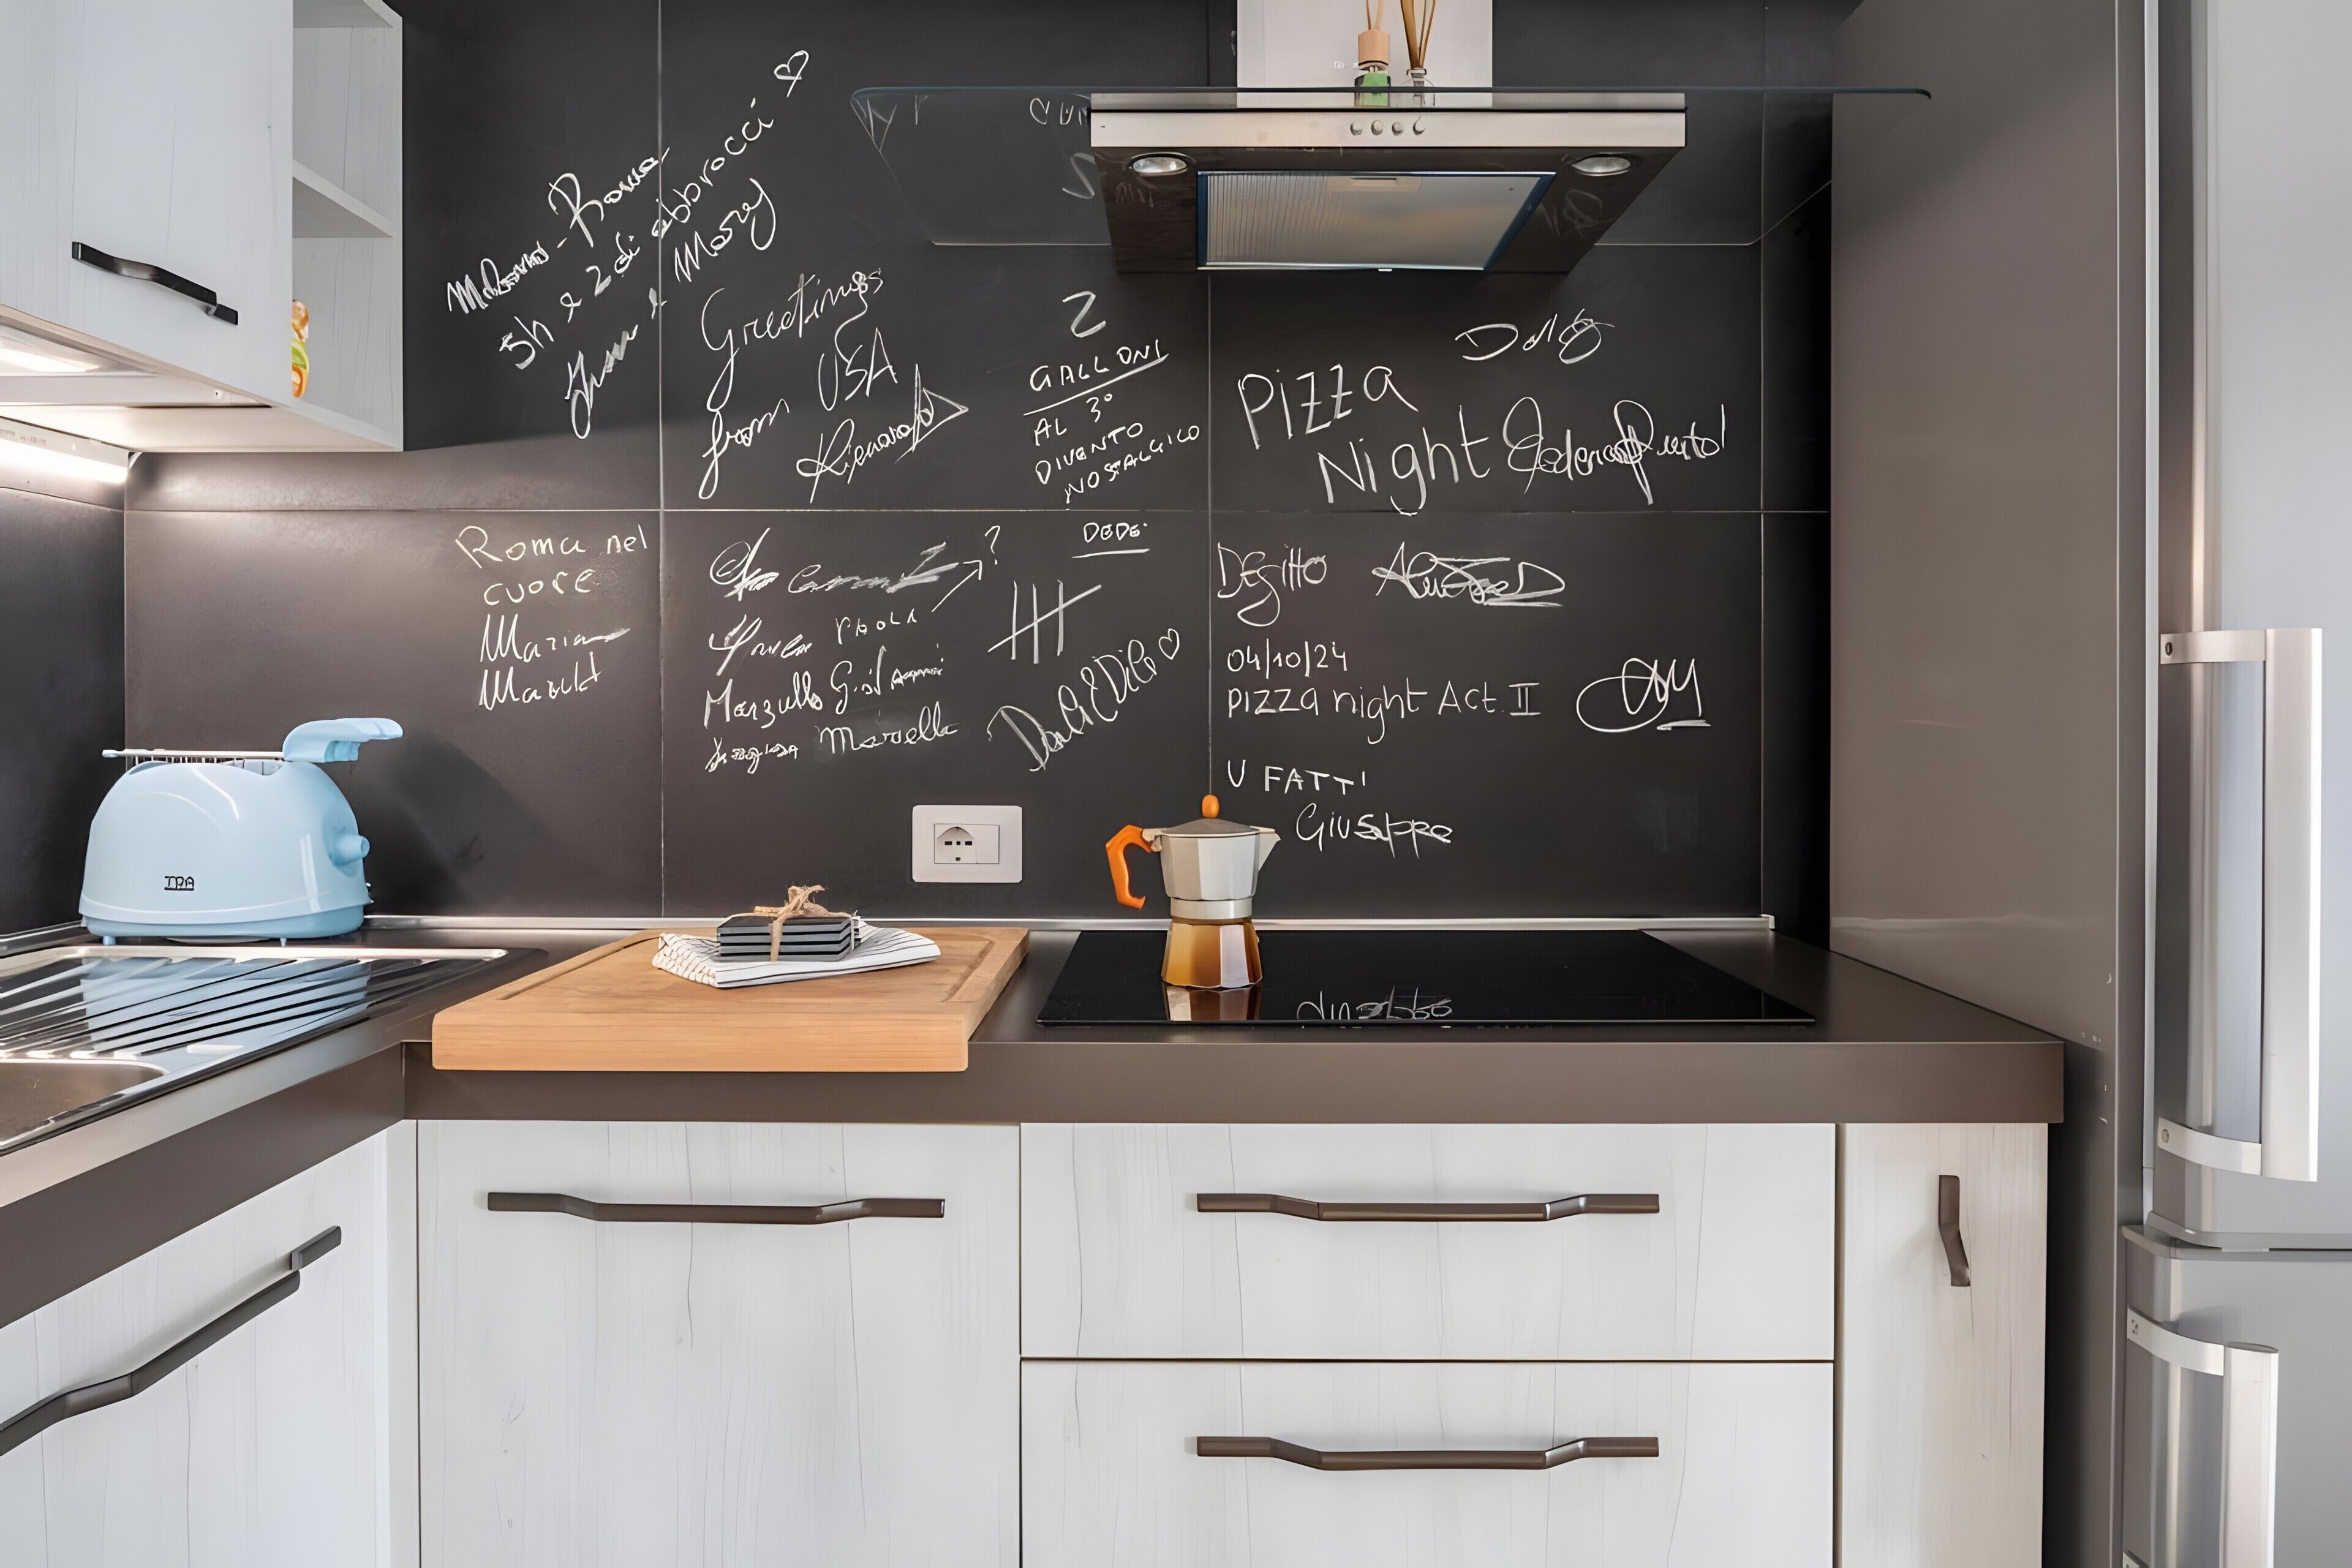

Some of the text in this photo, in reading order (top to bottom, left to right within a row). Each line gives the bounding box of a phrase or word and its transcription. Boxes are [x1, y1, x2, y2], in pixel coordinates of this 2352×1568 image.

[702, 270, 883, 412] Greetings
[1030, 339, 1163, 391] GALLONI
[699, 328, 897, 499] from USA
[1034, 418, 1067, 446] AL
[1035, 423, 1143, 484] DIVENTO
[1317, 405, 1490, 516] Night
[456, 524, 647, 568] Roma nel
[1227, 638, 1347, 679] 04/10/24
[1333, 677, 1427, 744] night
